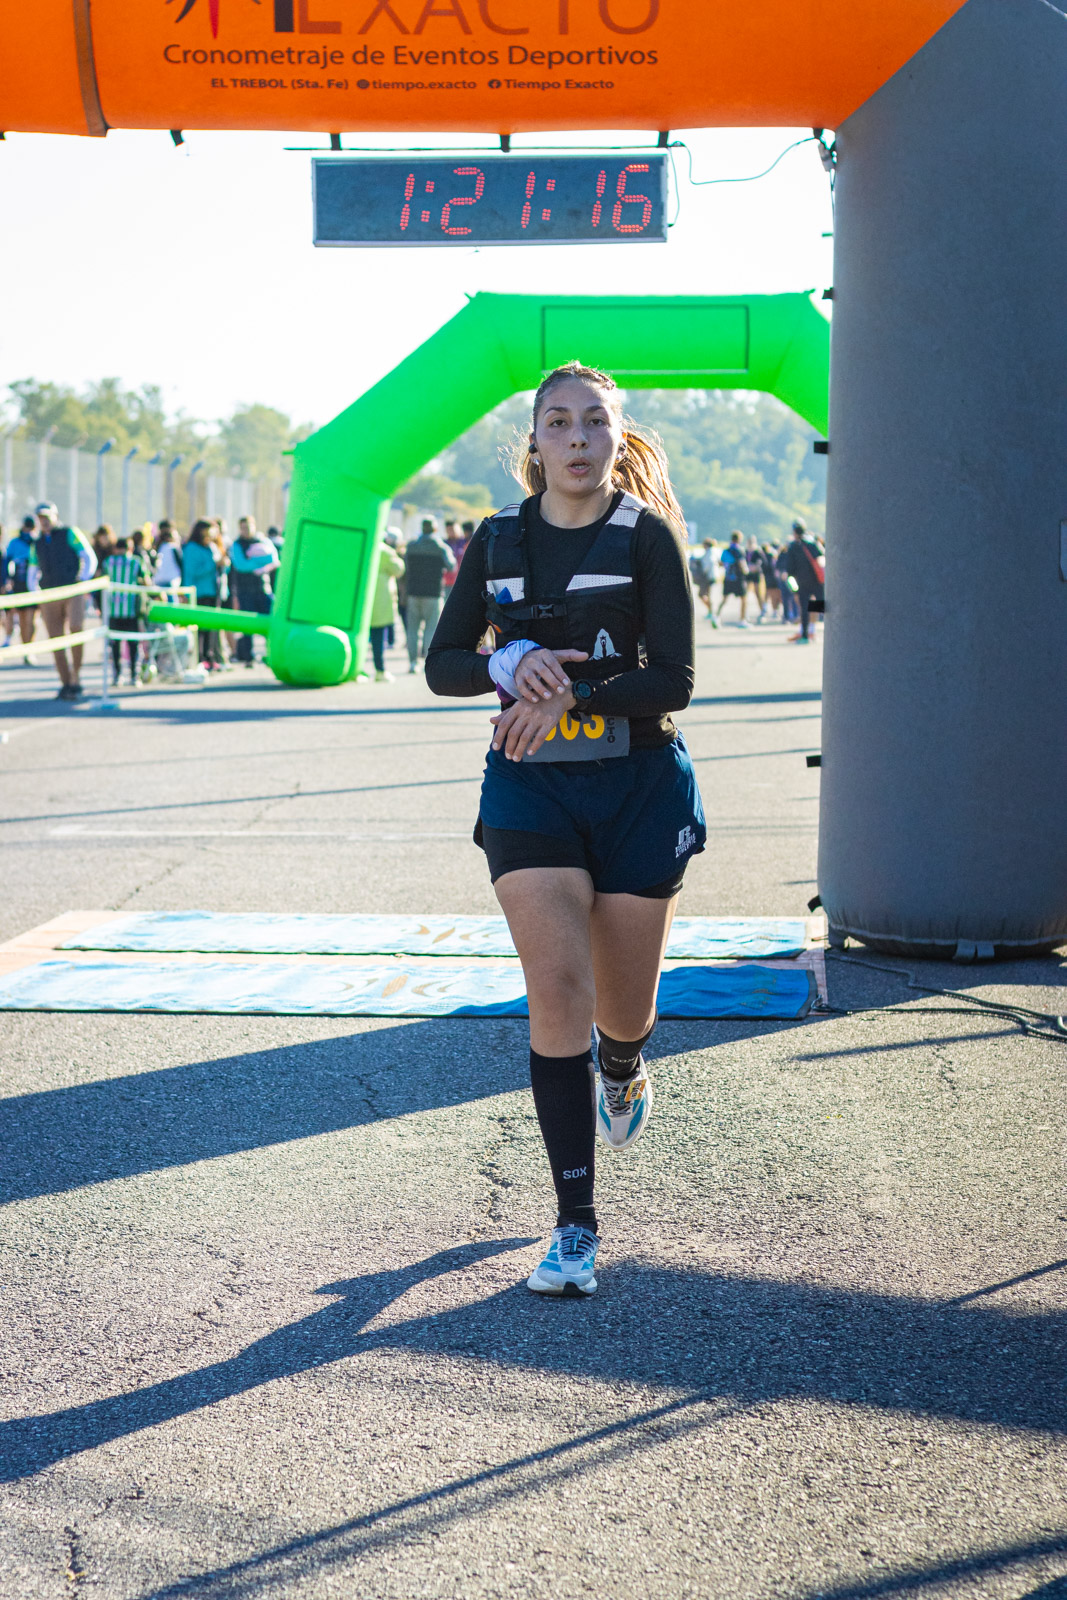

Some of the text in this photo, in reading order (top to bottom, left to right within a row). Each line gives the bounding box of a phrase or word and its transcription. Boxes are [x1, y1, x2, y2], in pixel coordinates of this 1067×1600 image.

[163, 44, 658, 69] Cronometraje de Eventos Deportivos
[211, 78, 614, 91] EL TREBOL (Sta. Fe) tiempo.exacto Tiempo Exacto
[563, 1166, 587, 1180] SOX
